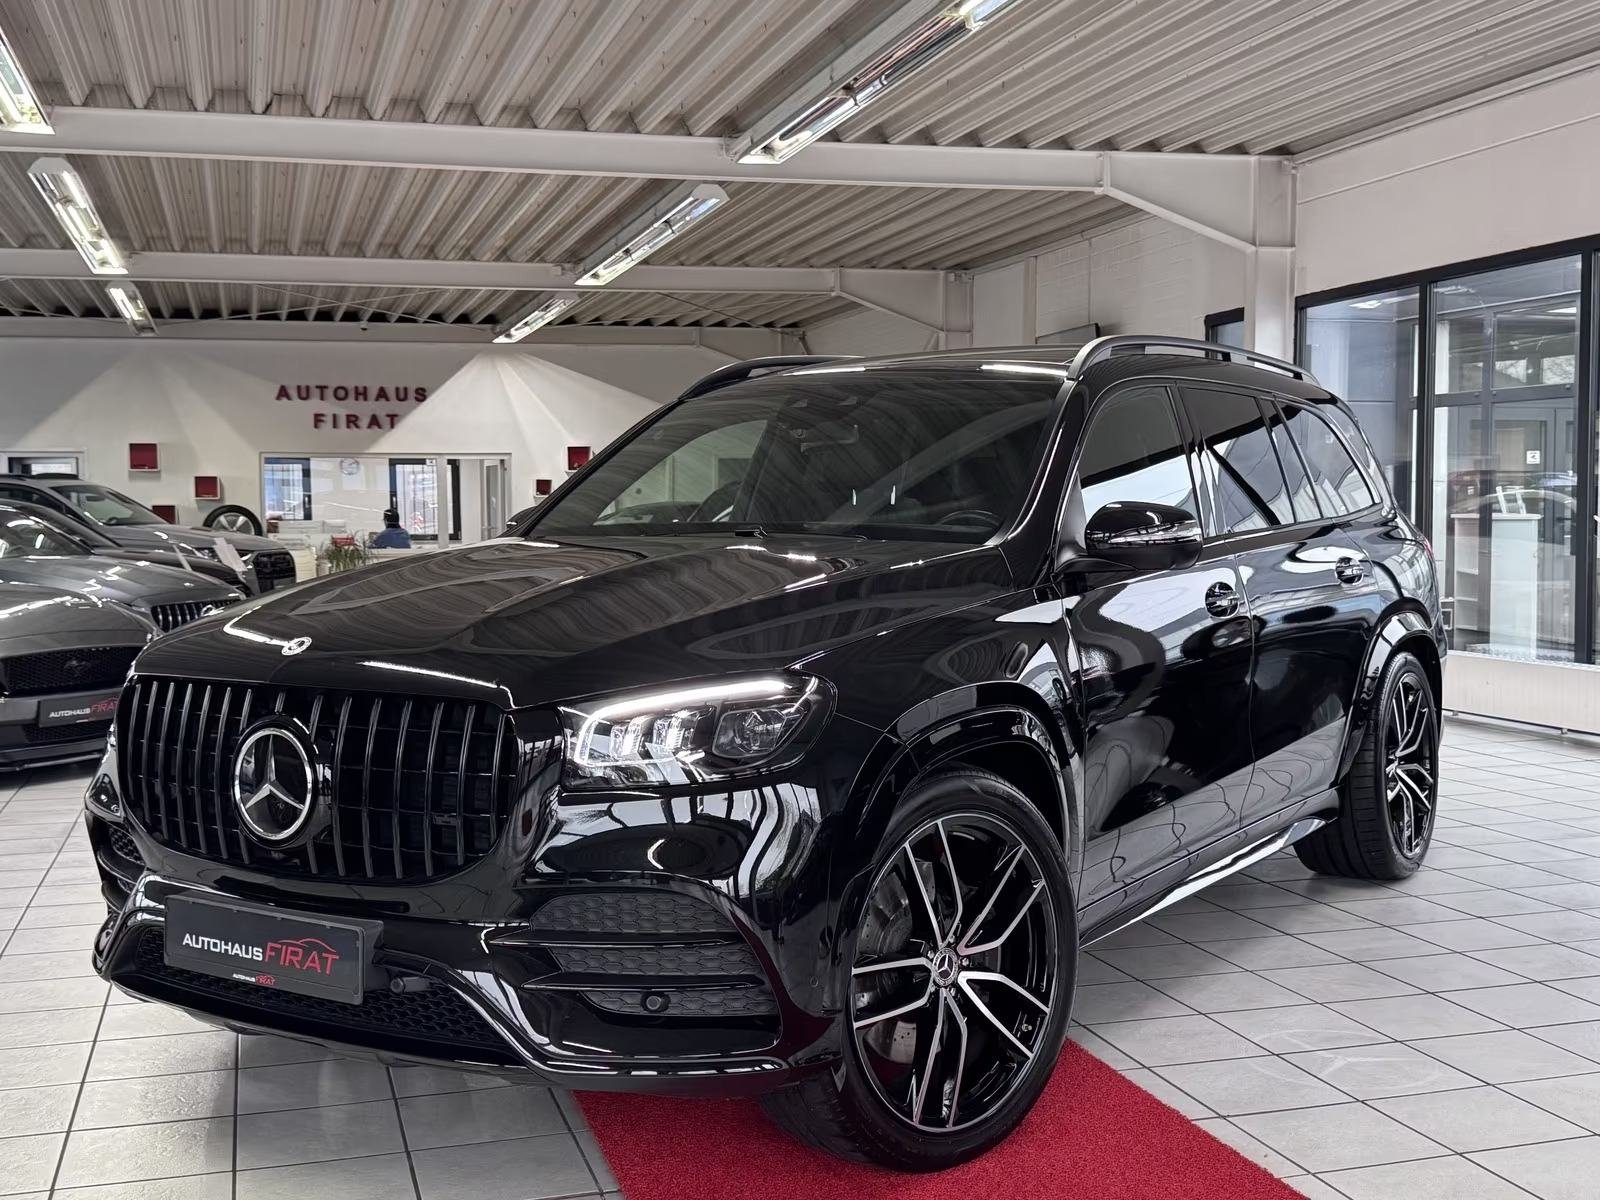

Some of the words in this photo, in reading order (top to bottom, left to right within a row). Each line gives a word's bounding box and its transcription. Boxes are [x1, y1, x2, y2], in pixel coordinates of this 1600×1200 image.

[276, 384, 428, 403] AUTOHAUS
[313, 413, 399, 429] FIRAT
[49, 708, 91, 718] AUTOHAUS
[182, 933, 264, 962] AUTOHAUS
[264, 941, 340, 976] FIRAT
